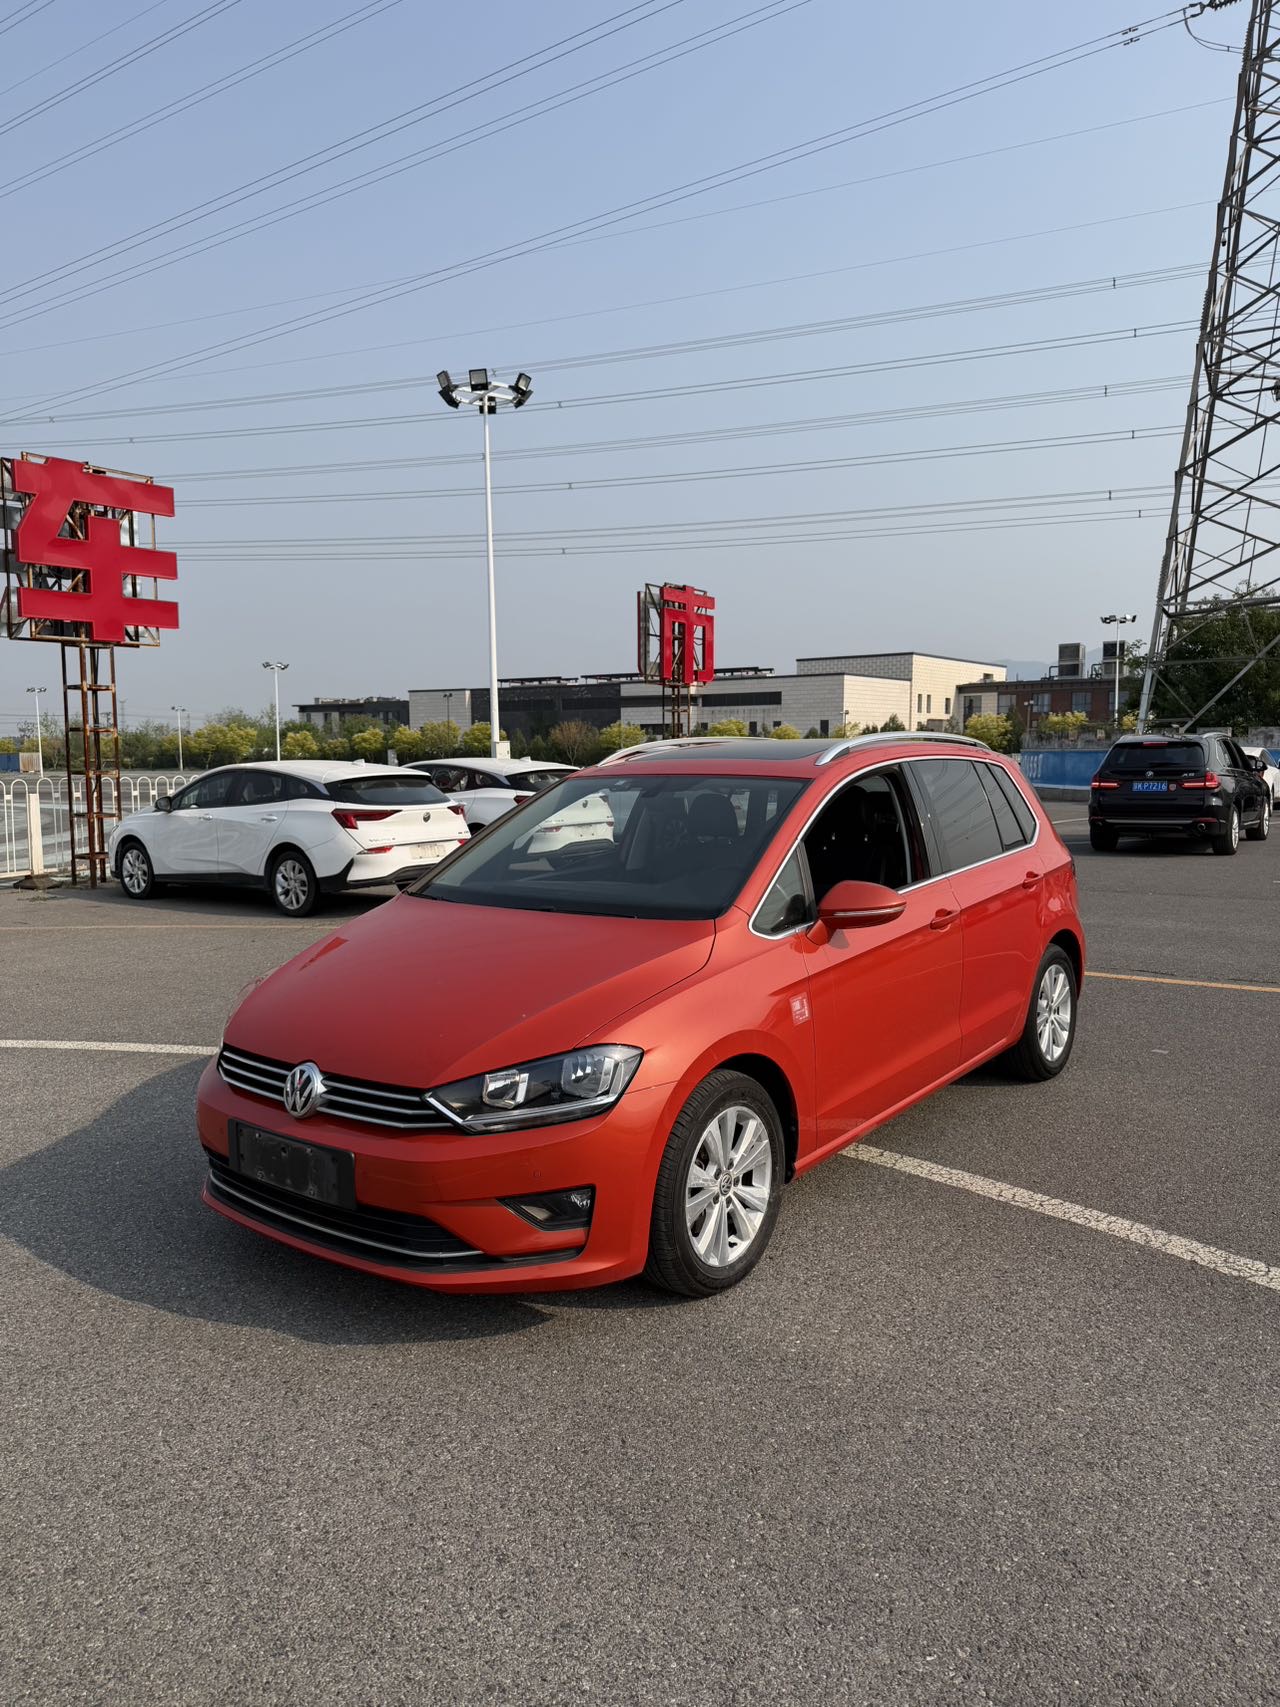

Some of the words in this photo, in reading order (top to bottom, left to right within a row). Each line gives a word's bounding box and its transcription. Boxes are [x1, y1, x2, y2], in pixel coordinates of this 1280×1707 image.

[12, 457, 179, 642] 车
[660, 585, 716, 685] 市
[1132, 782, 1167, 790] KP7216
